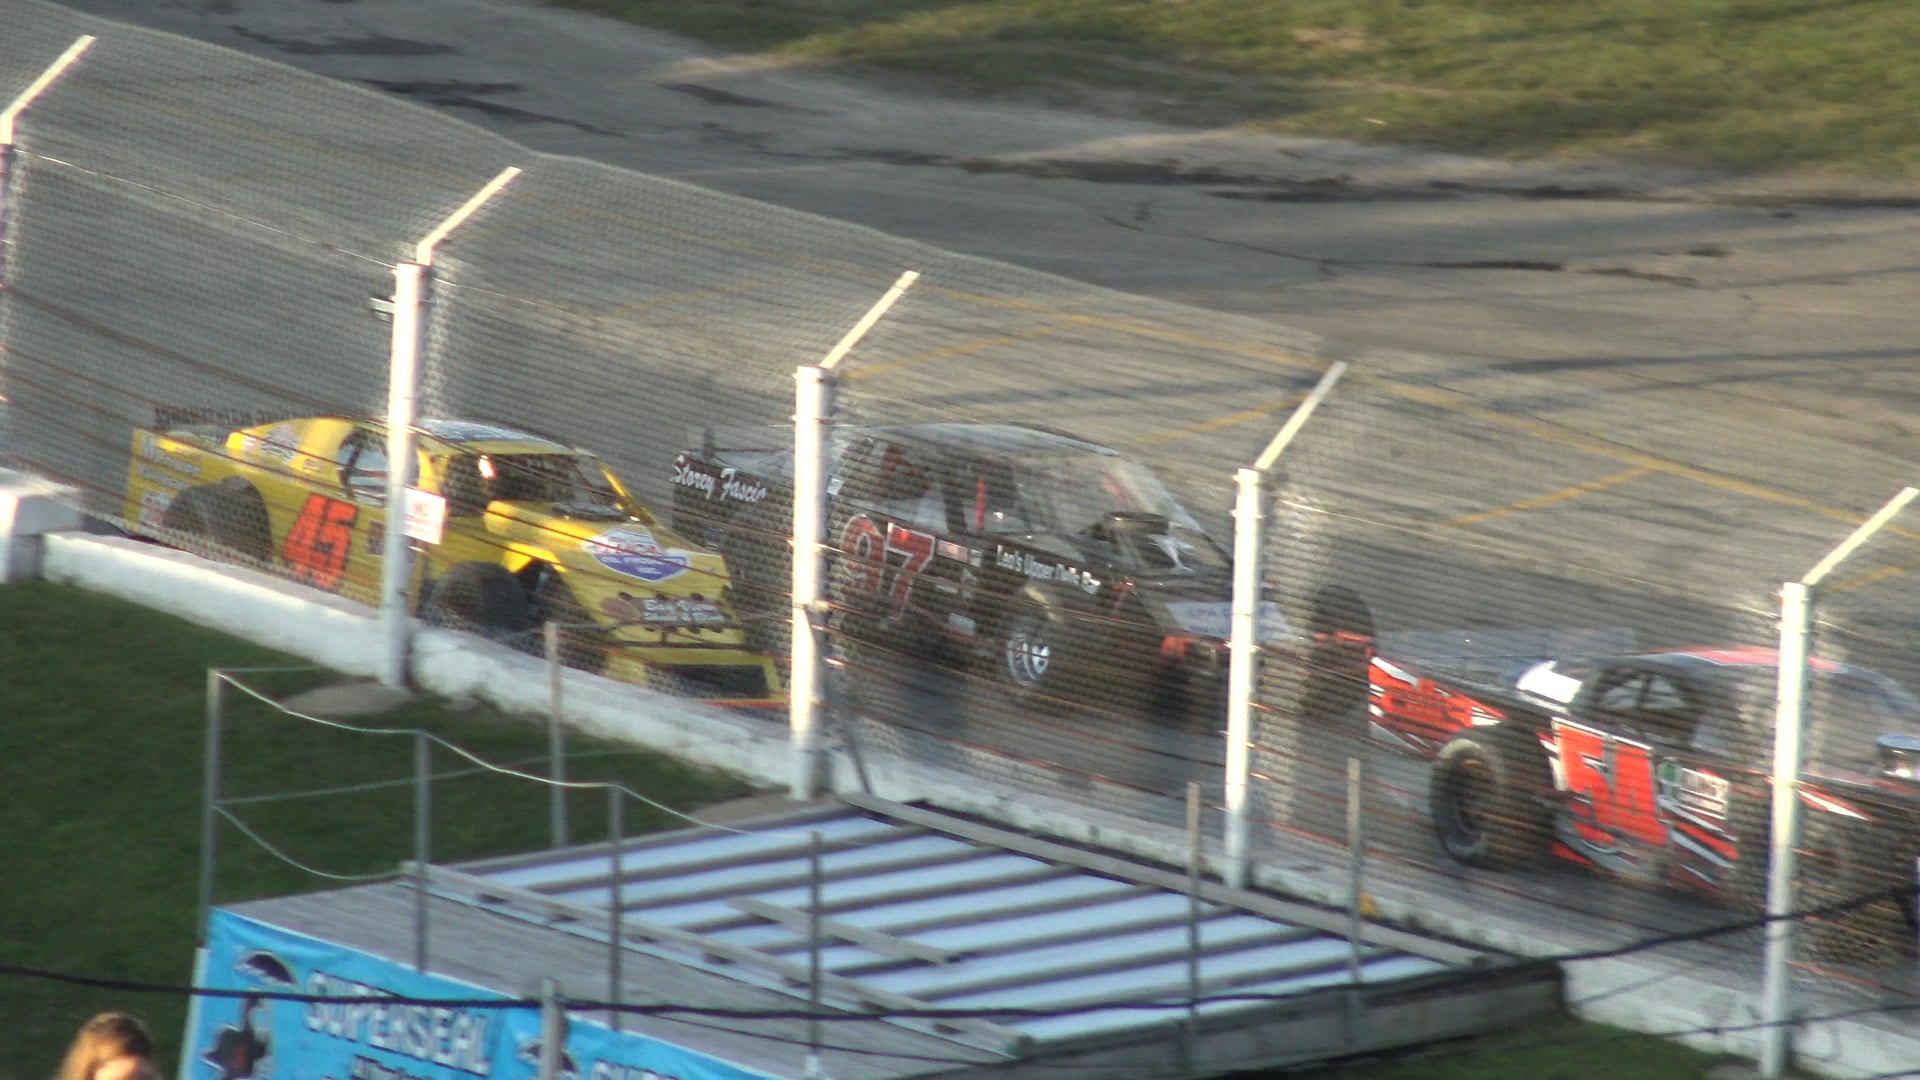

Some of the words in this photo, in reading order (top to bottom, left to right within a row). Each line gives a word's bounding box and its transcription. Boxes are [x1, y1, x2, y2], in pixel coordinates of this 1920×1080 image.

[283, 492, 359, 588] 45
[841, 513, 936, 621] 97
[303, 969, 490, 1077] SUPERSEAL
